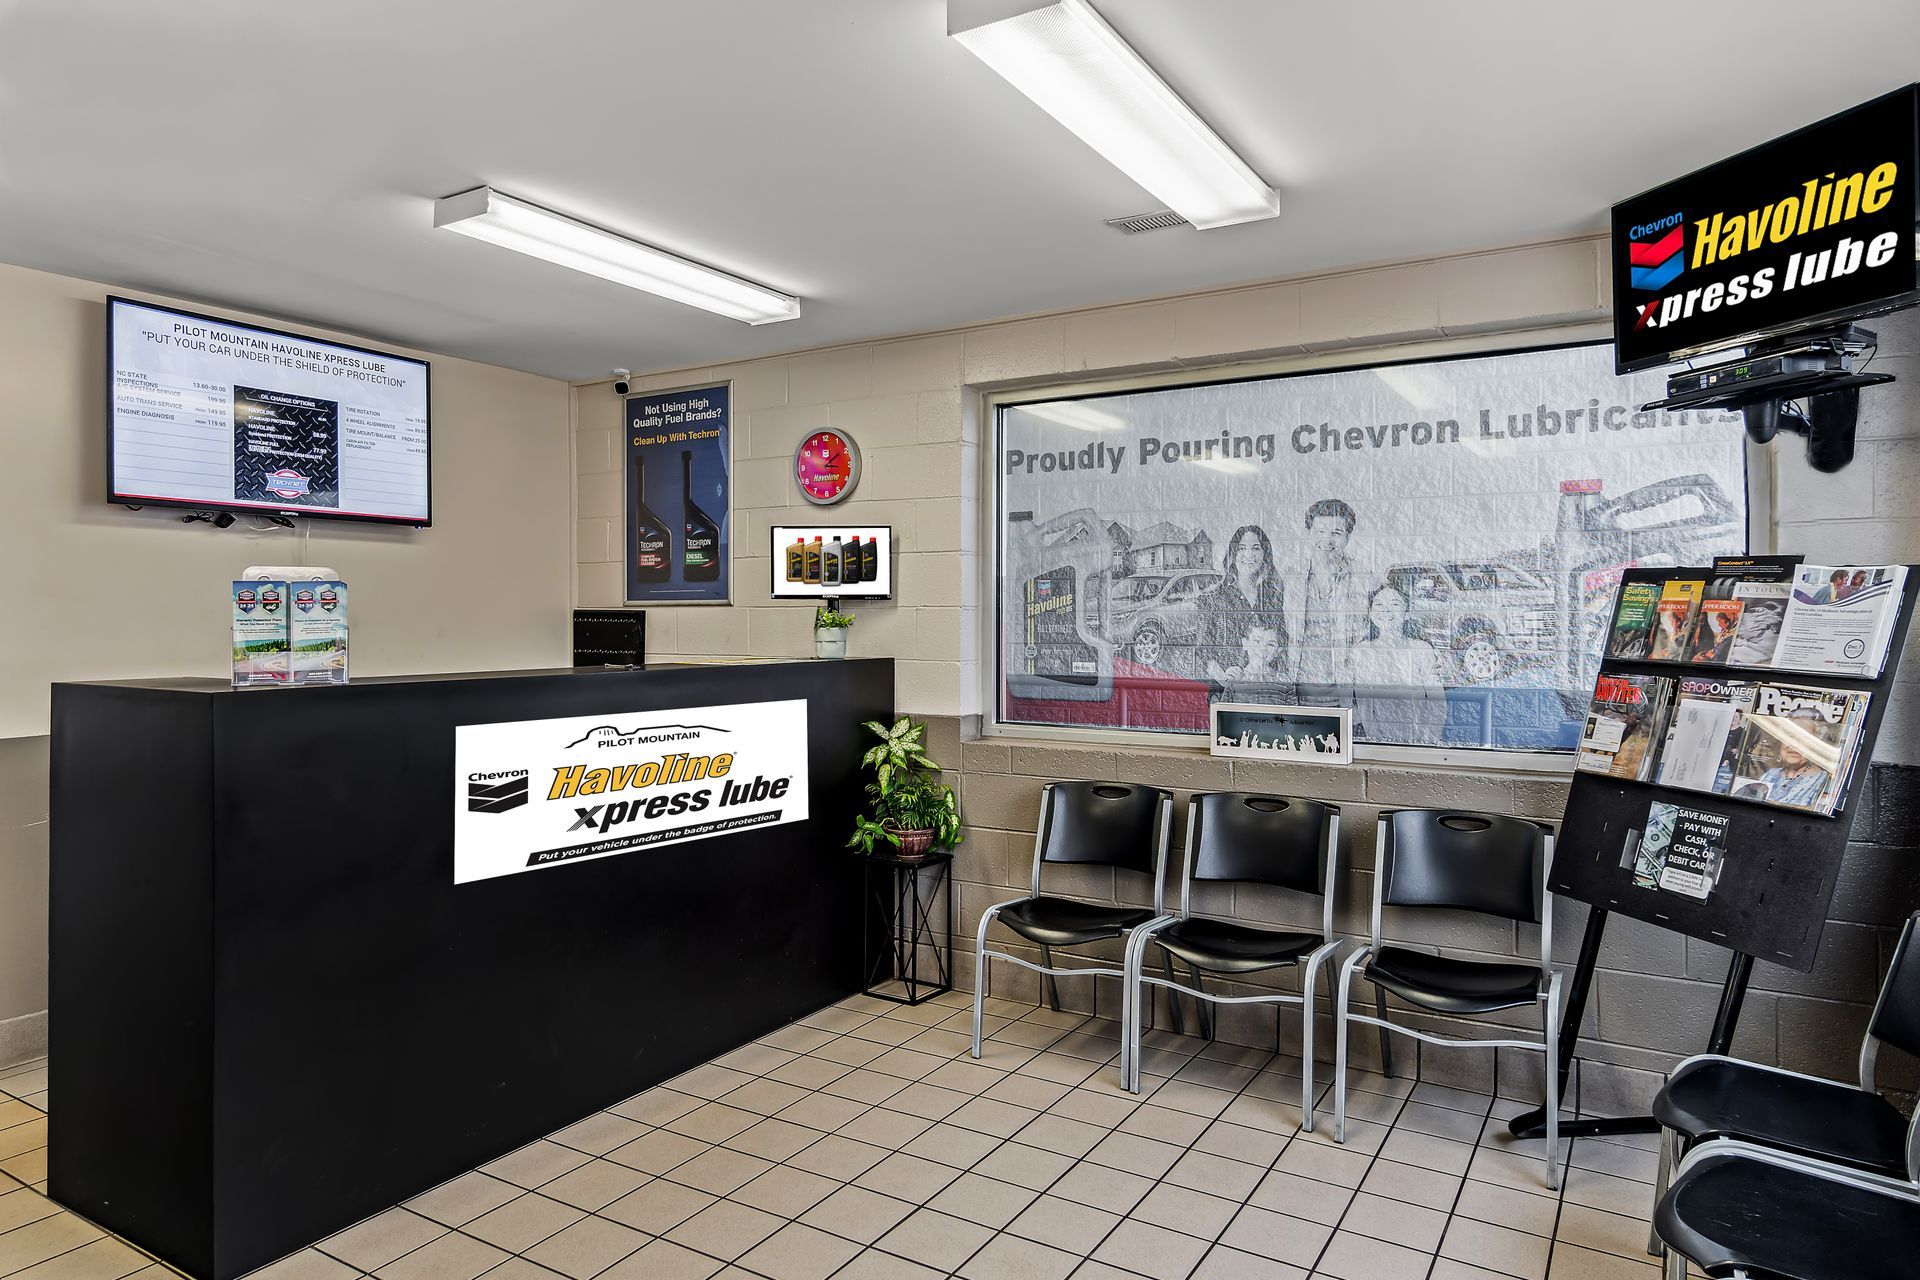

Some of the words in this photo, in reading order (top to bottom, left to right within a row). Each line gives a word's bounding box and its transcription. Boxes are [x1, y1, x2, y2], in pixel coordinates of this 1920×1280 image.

[1690, 161, 1898, 270] Havoline
[1629, 211, 1683, 240] Chevron
[1633, 267, 1775, 331] xpress
[1782, 230, 1899, 292] lube
[174, 323, 208, 338] PILOT
[210, 330, 269, 350] MOUNTAIN
[271, 343, 322, 360] HAVOLINE
[324, 353, 360, 368] XPRESS
[362, 360, 386, 373] LUBE
[142, 330, 171, 344] "PUT
[174, 337, 206, 352] YOUR
[209, 344, 232, 356] CAR
[234, 348, 270, 363] UNDER
[273, 355, 293, 368] THE
[295, 360, 330, 374] SHIELD
[332, 367, 344, 377] OF
[346, 370, 406, 388] PROTECTION"
[116, 377, 158, 388] INSPECTIONS
[128, 372, 148, 380] STATE
[156, 388, 182, 397] SERVICE
[136, 398, 157, 406] TRANS
[158, 400, 183, 410] SERVICE
[270, 394, 292, 404] CHANGE
[292, 399, 316, 408] OPTIONS
[645, 405, 660, 416] Not
[662, 402, 687, 413] Using
[688, 398, 709, 410] High
[116, 408, 141, 416] ENGINE
[142, 410, 175, 420] DIAGNOSIS
[248, 408, 276, 416] HAVOLINE
[357, 409, 381, 417] ROTATION
[633, 416, 663, 428] Quality
[665, 413, 683, 424] Fuel
[686, 408, 722, 422] Brands?
[248, 424, 276, 432] HAVOLINE
[633, 436, 656, 446] Clean
[656, 434, 668, 444] Up
[669, 432, 687, 442] With
[688, 429, 720, 440] Techron
[822, 434, 828, 442] 12
[1006, 440, 1126, 476] Proudly
[1139, 430, 1276, 464] Pouring
[1291, 418, 1460, 454] Chevron
[802, 464, 806, 472] 9
[814, 473, 840, 482] Havoline
[824, 490, 830, 498] 6
[686, 538, 712, 546] TECHRON
[1028, 593, 1073, 618] Havoline
[1599, 674, 1628, 686] American
[1596, 683, 1642, 704] HUNTER
[598, 738, 635, 748] PILOT
[638, 731, 700, 744] MOUNTAIN
[468, 769, 529, 782] Chevron
[547, 752, 734, 800] Havoline
[566, 789, 712, 834] xpress
[719, 775, 790, 808] lube
[1678, 809, 1698, 820] SAVE
[1698, 813, 1728, 826] MONEY
[1684, 822, 1700, 832] PAY
[1700, 825, 1722, 836] WITH
[538, 853, 558, 862] Put
[562, 847, 588, 860] your
[591, 838, 630, 852] vehicle
[632, 834, 662, 844] under
[665, 830, 682, 838] the
[684, 824, 714, 836] badge
[716, 821, 728, 830] of
[728, 812, 777, 828] protection.
[1685, 834, 1708, 848] CASH,
[1674, 844, 1700, 858] CHECK,
[1702, 850, 1715, 860] OR
[1668, 854, 1690, 866] DEBIT
